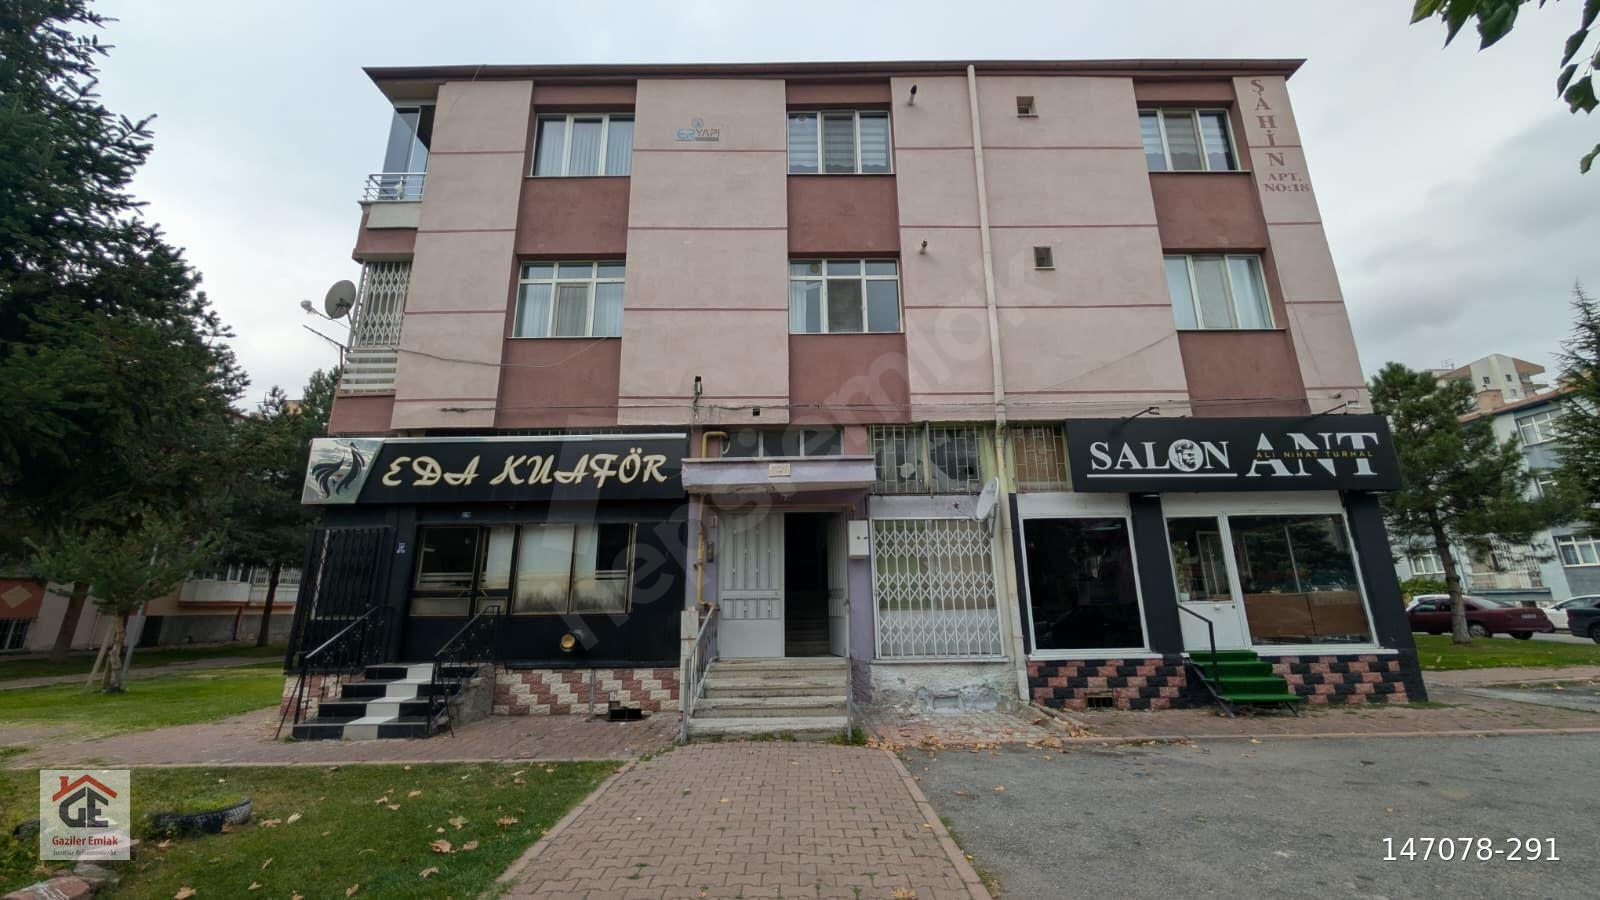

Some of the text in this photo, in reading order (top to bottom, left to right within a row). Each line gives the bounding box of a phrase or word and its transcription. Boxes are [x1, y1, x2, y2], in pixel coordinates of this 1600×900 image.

[1264, 183, 1311, 193] NO:18
[382, 447, 669, 488] EDA KUAFÖR
[1089, 432, 1379, 477] SALON ANT
